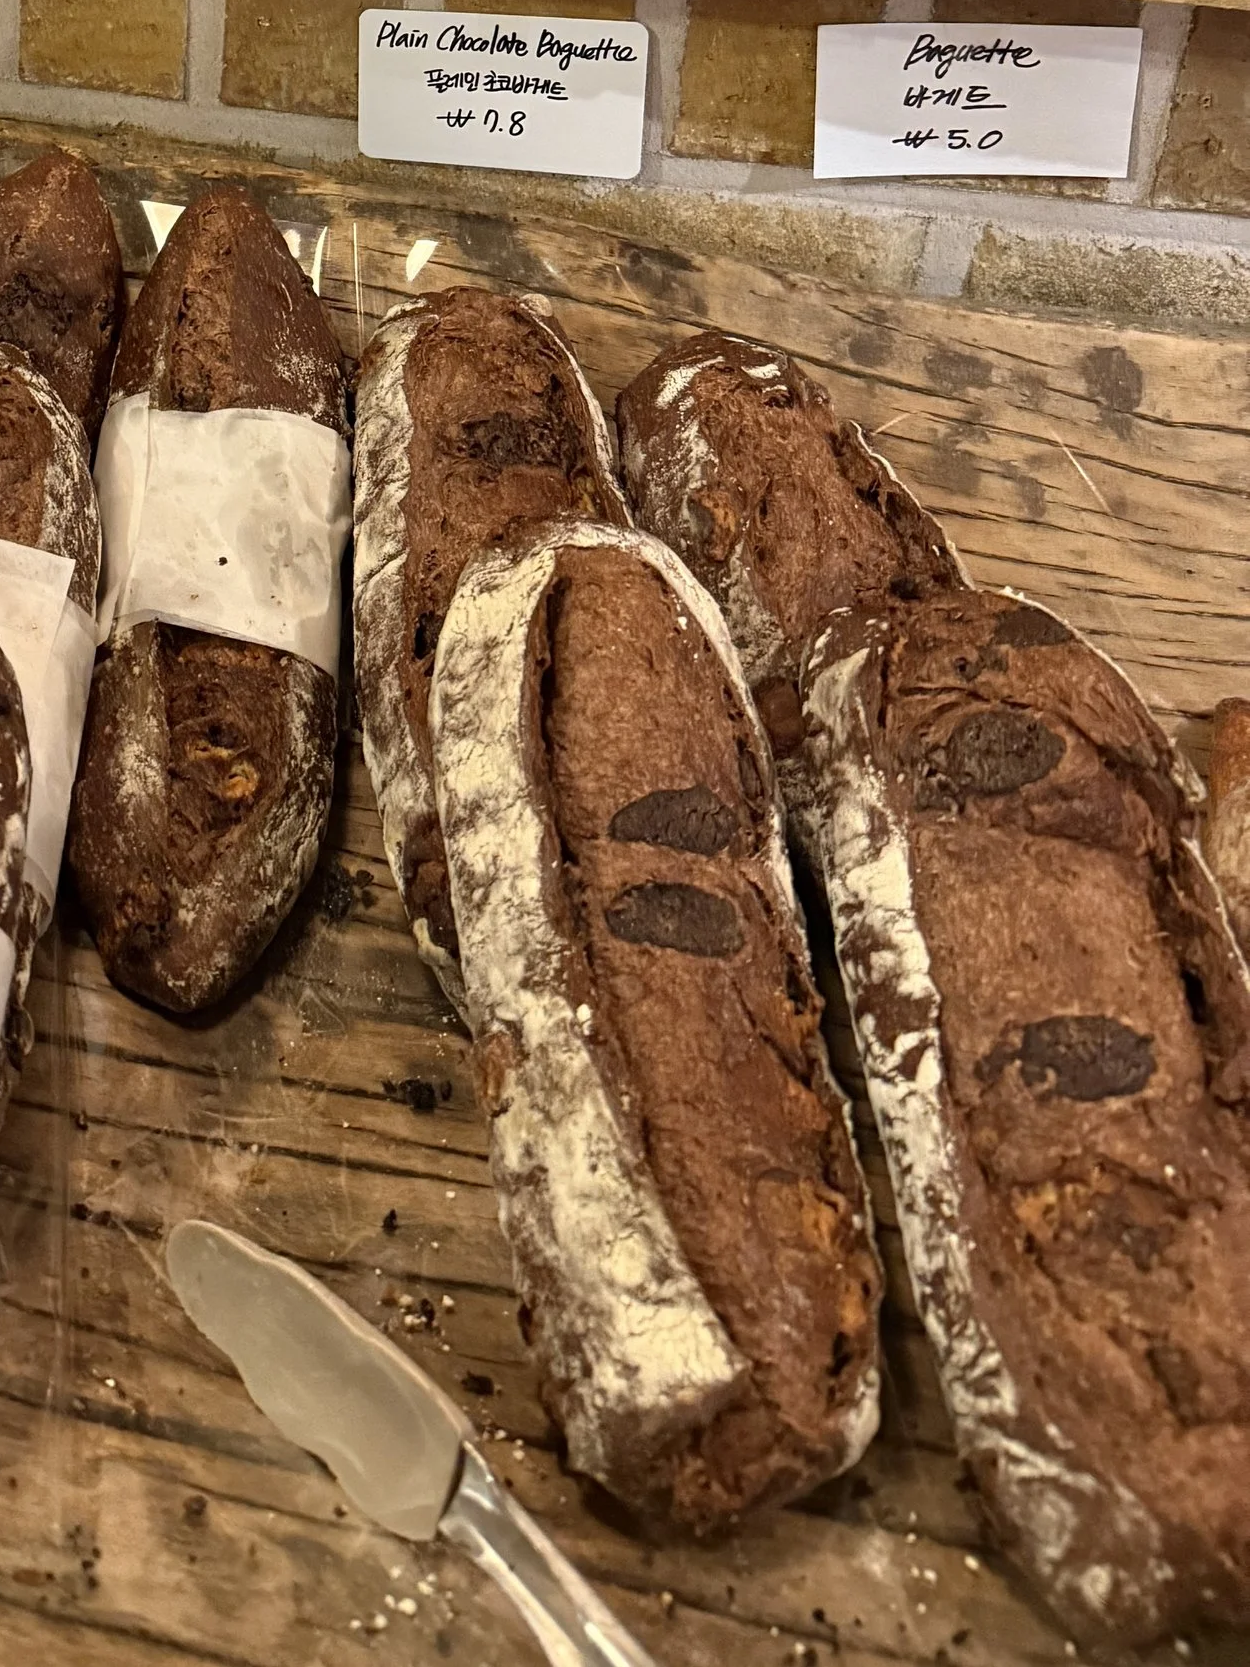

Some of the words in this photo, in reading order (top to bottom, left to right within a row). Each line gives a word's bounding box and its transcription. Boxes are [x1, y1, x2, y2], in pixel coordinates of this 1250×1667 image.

[376, 20, 429, 48] Plain
[436, 24, 528, 57] Chocolate
[536, 28, 638, 71] Baguette
[903, 33, 1041, 79] Baguette
[903, 85, 1007, 110] 바게트
